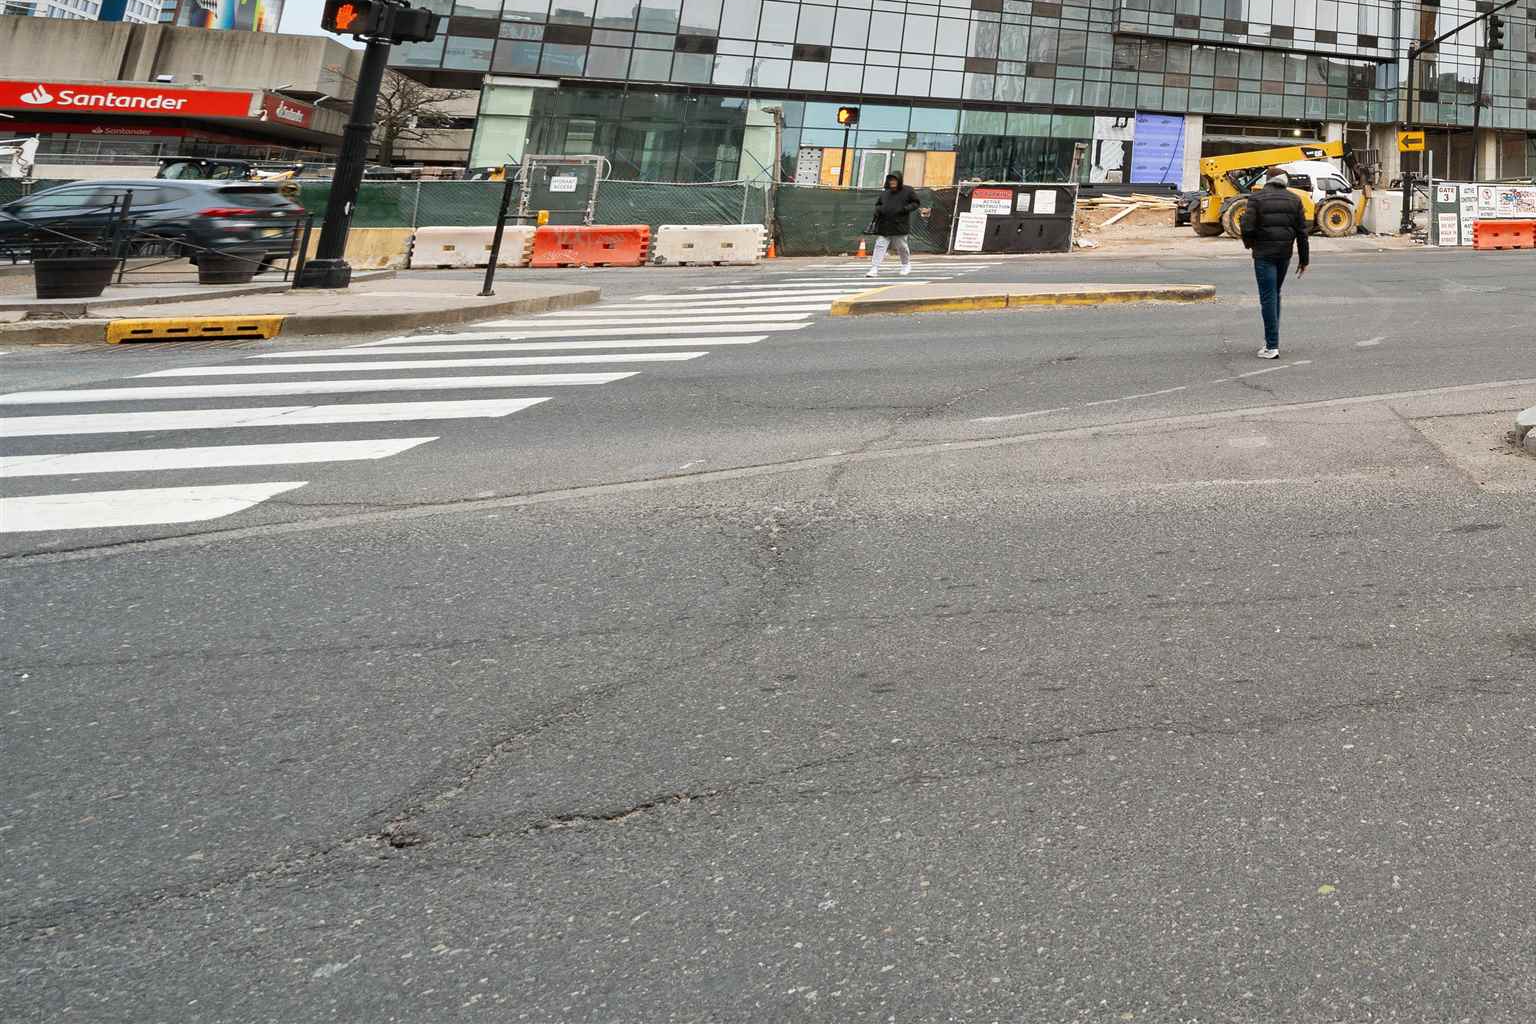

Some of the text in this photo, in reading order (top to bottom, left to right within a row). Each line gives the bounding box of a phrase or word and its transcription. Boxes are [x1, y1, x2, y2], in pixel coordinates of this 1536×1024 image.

[57, 90, 187, 111] Santander
[104, 127, 152, 136] Santander
[1443, 193, 1449, 202] 3
